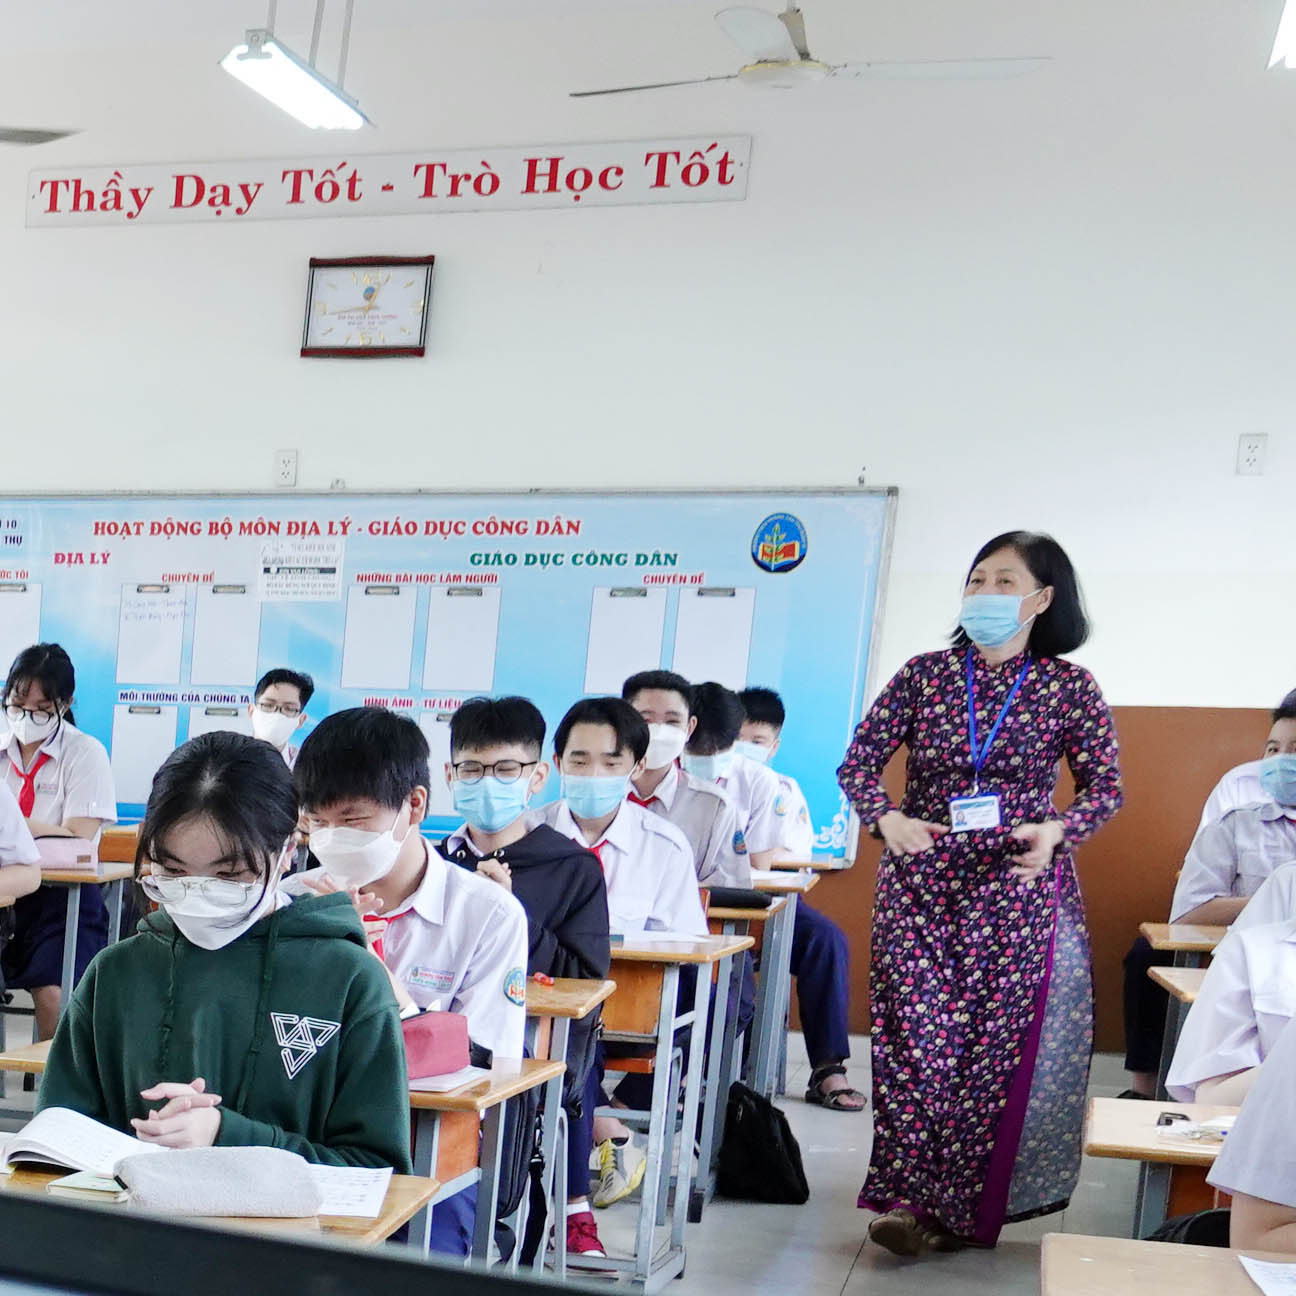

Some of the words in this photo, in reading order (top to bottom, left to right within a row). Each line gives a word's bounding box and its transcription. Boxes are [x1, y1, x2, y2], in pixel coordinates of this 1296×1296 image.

[40, 171, 154, 219] Thầy
[169, 173, 264, 216] Dạy
[281, 161, 364, 205] Tốt
[413, 160, 501, 199] Trò
[520, 157, 624, 202] Học
[644, 142, 735, 188] Tốt
[93, 521, 144, 540] HOẠT
[149, 517, 202, 540] ĐỘNG
[208, 516, 233, 540] BỘ
[238, 517, 281, 536] MÔN
[286, 520, 321, 540] ĐỊA
[327, 517, 352, 536] LÝ
[368, 516, 418, 536] GIÁO
[423, 520, 467, 540] DỤC
[471, 516, 530, 536] CÔNG
[535, 516, 581, 536] DÂN
[54, 552, 84, 567] ĐỊA
[90, 550, 111, 565] LÝ
[470, 550, 518, 566] GIÁO
[524, 552, 565, 569] DỤC
[571, 550, 628, 566] CÔNG
[634, 550, 679, 566] DÂN
